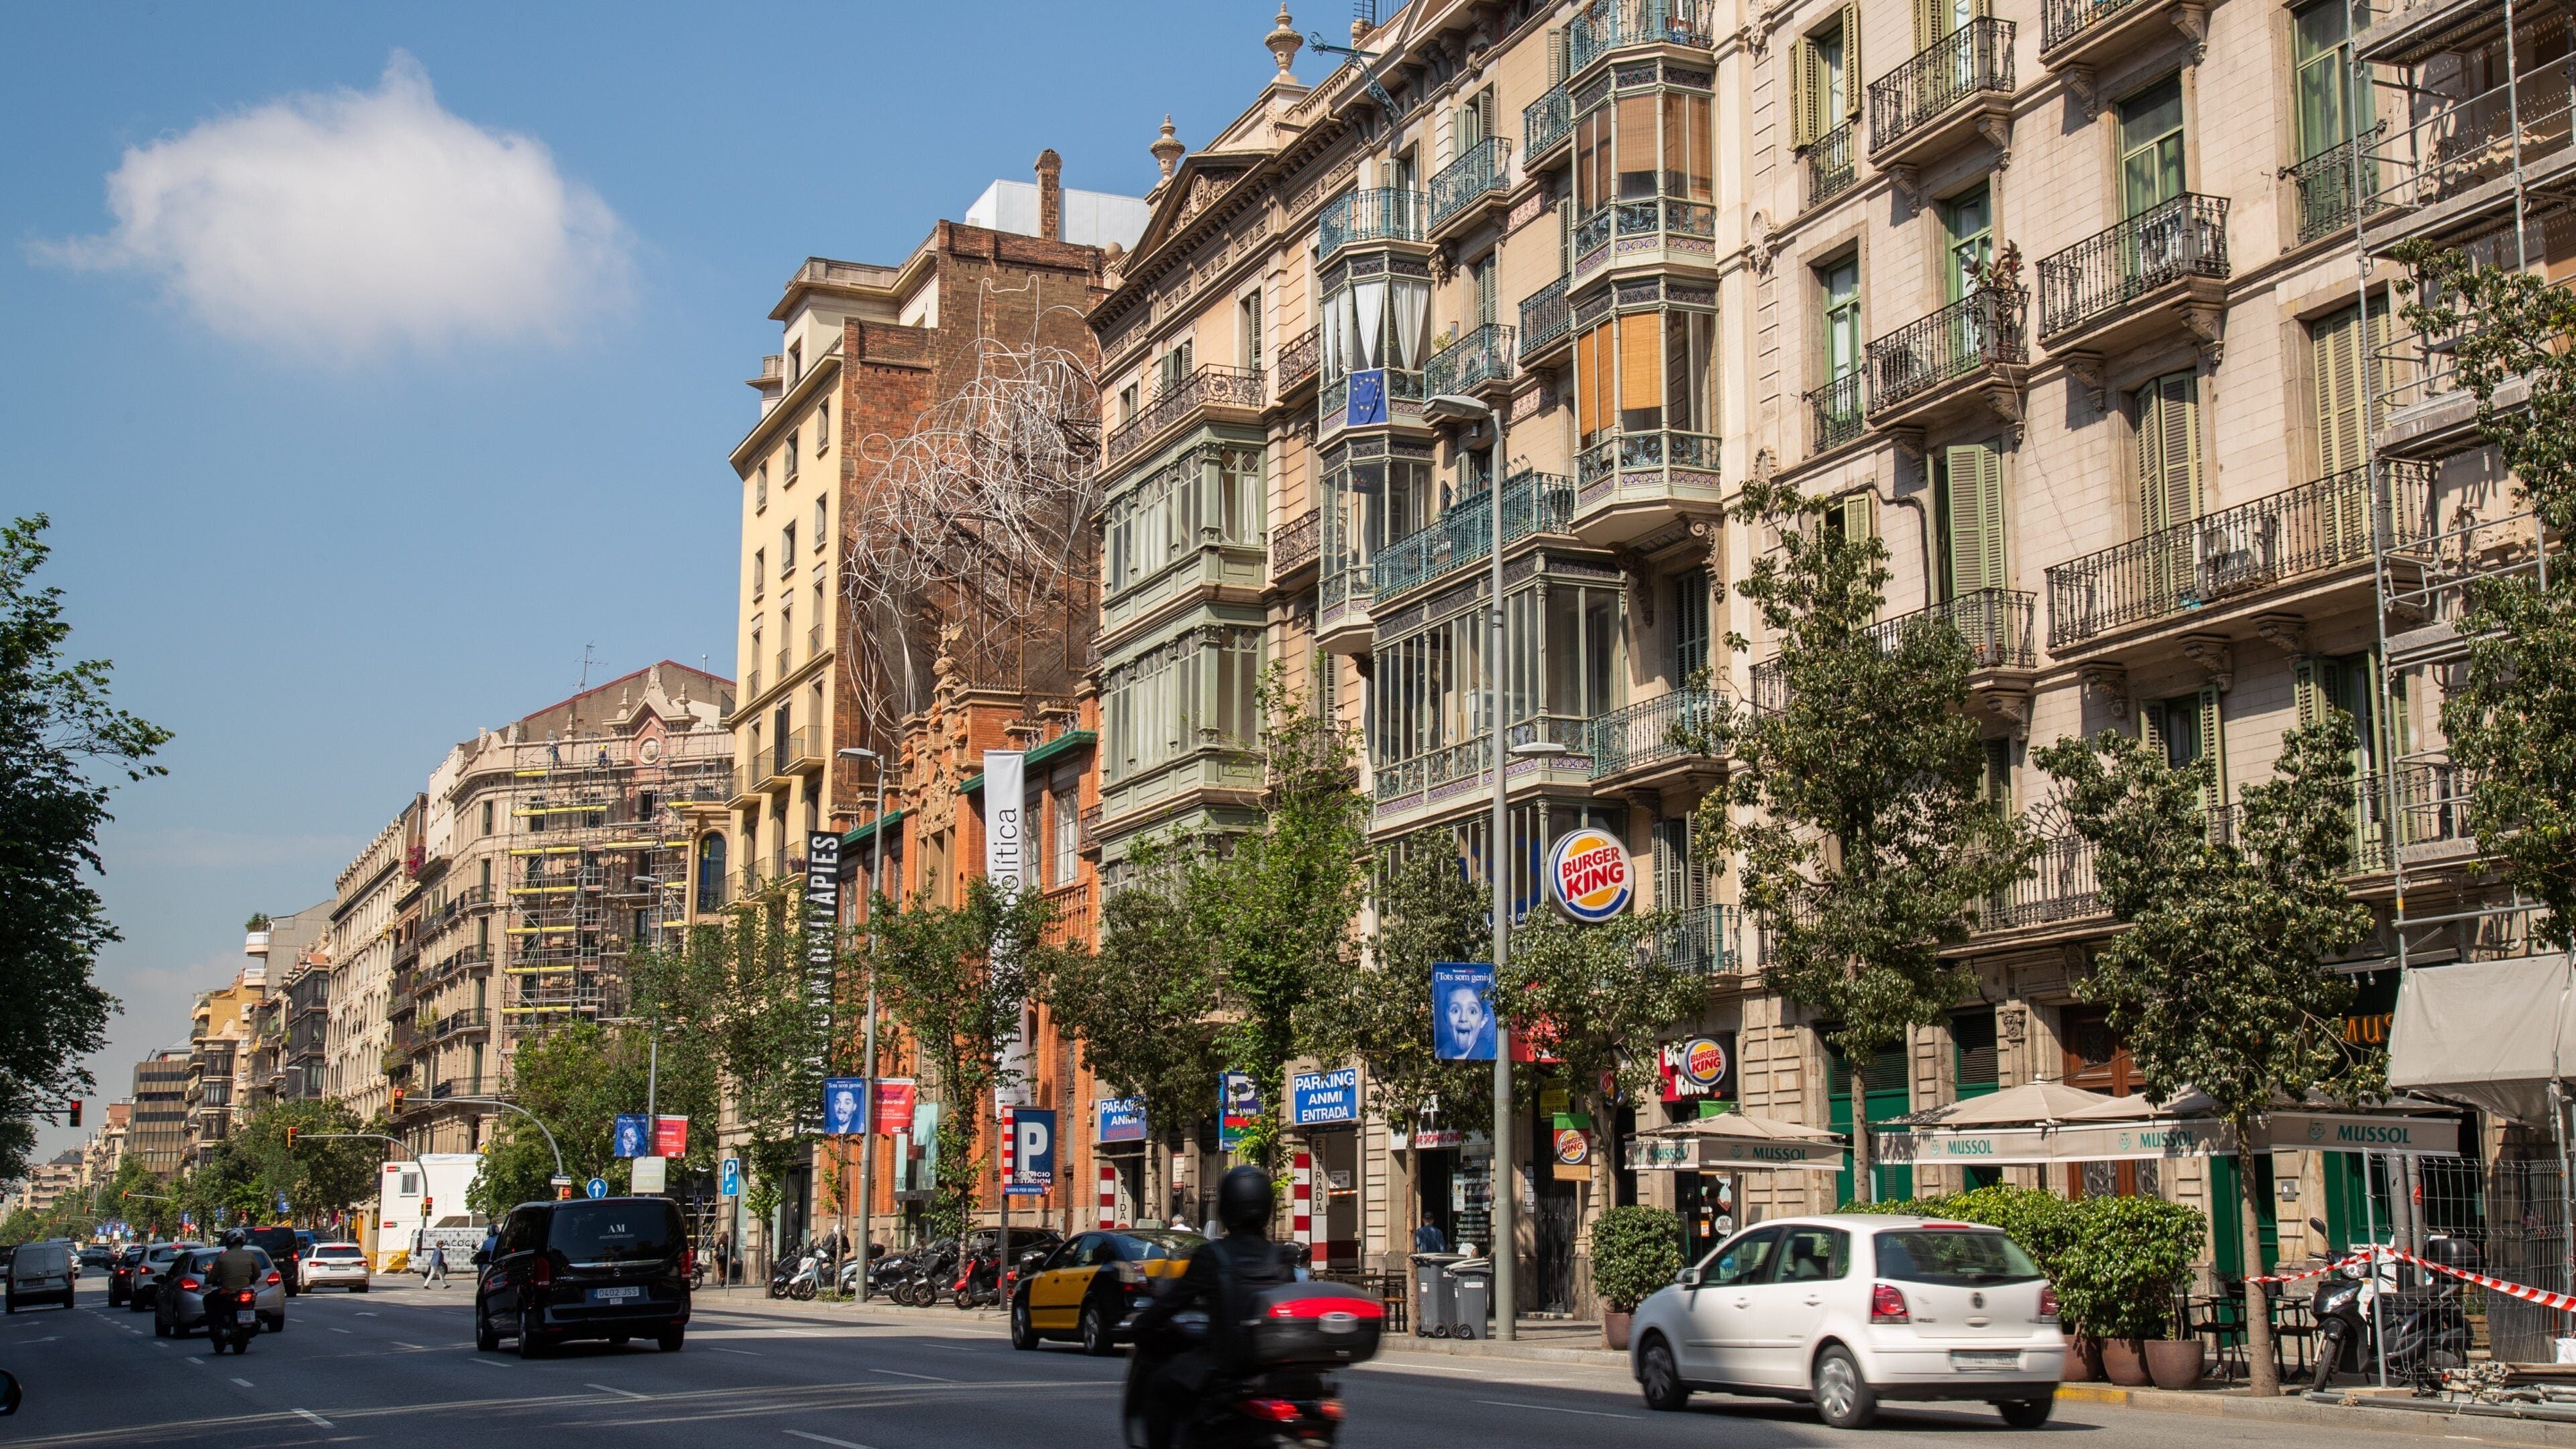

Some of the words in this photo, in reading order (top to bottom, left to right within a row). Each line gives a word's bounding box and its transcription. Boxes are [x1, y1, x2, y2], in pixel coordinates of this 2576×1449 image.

[1562, 847, 1621, 879] BURGER
[1566, 861, 1624, 902] KING
[1690, 1050, 1720, 1063] BURGER
[1692, 1057, 1721, 1075] KING
[1295, 1071, 1355, 1092] PARKING
[1228, 1076, 1256, 1115] P
[1308, 1091, 1342, 1106] ANMI
[1111, 1115, 1137, 1126] ANMI
[1302, 1106, 1349, 1122] ENTRADA
[1561, 1136, 1582, 1147] BURGER
[2140, 1130, 2195, 1148] MUSSOL
[2337, 1124, 2412, 1144] MUSSOL
[1018, 1122, 1048, 1171] P
[1561, 1142, 1583, 1157] KING
[1752, 1146, 1807, 1161] MUSSOL
[1947, 1140, 1993, 1155] MUSSOL
[725, 1161, 736, 1181] P
[608, 1224, 625, 1233] AM
[599, 1289, 619, 1297] 0402
[622, 1287, 637, 1295] JSS
